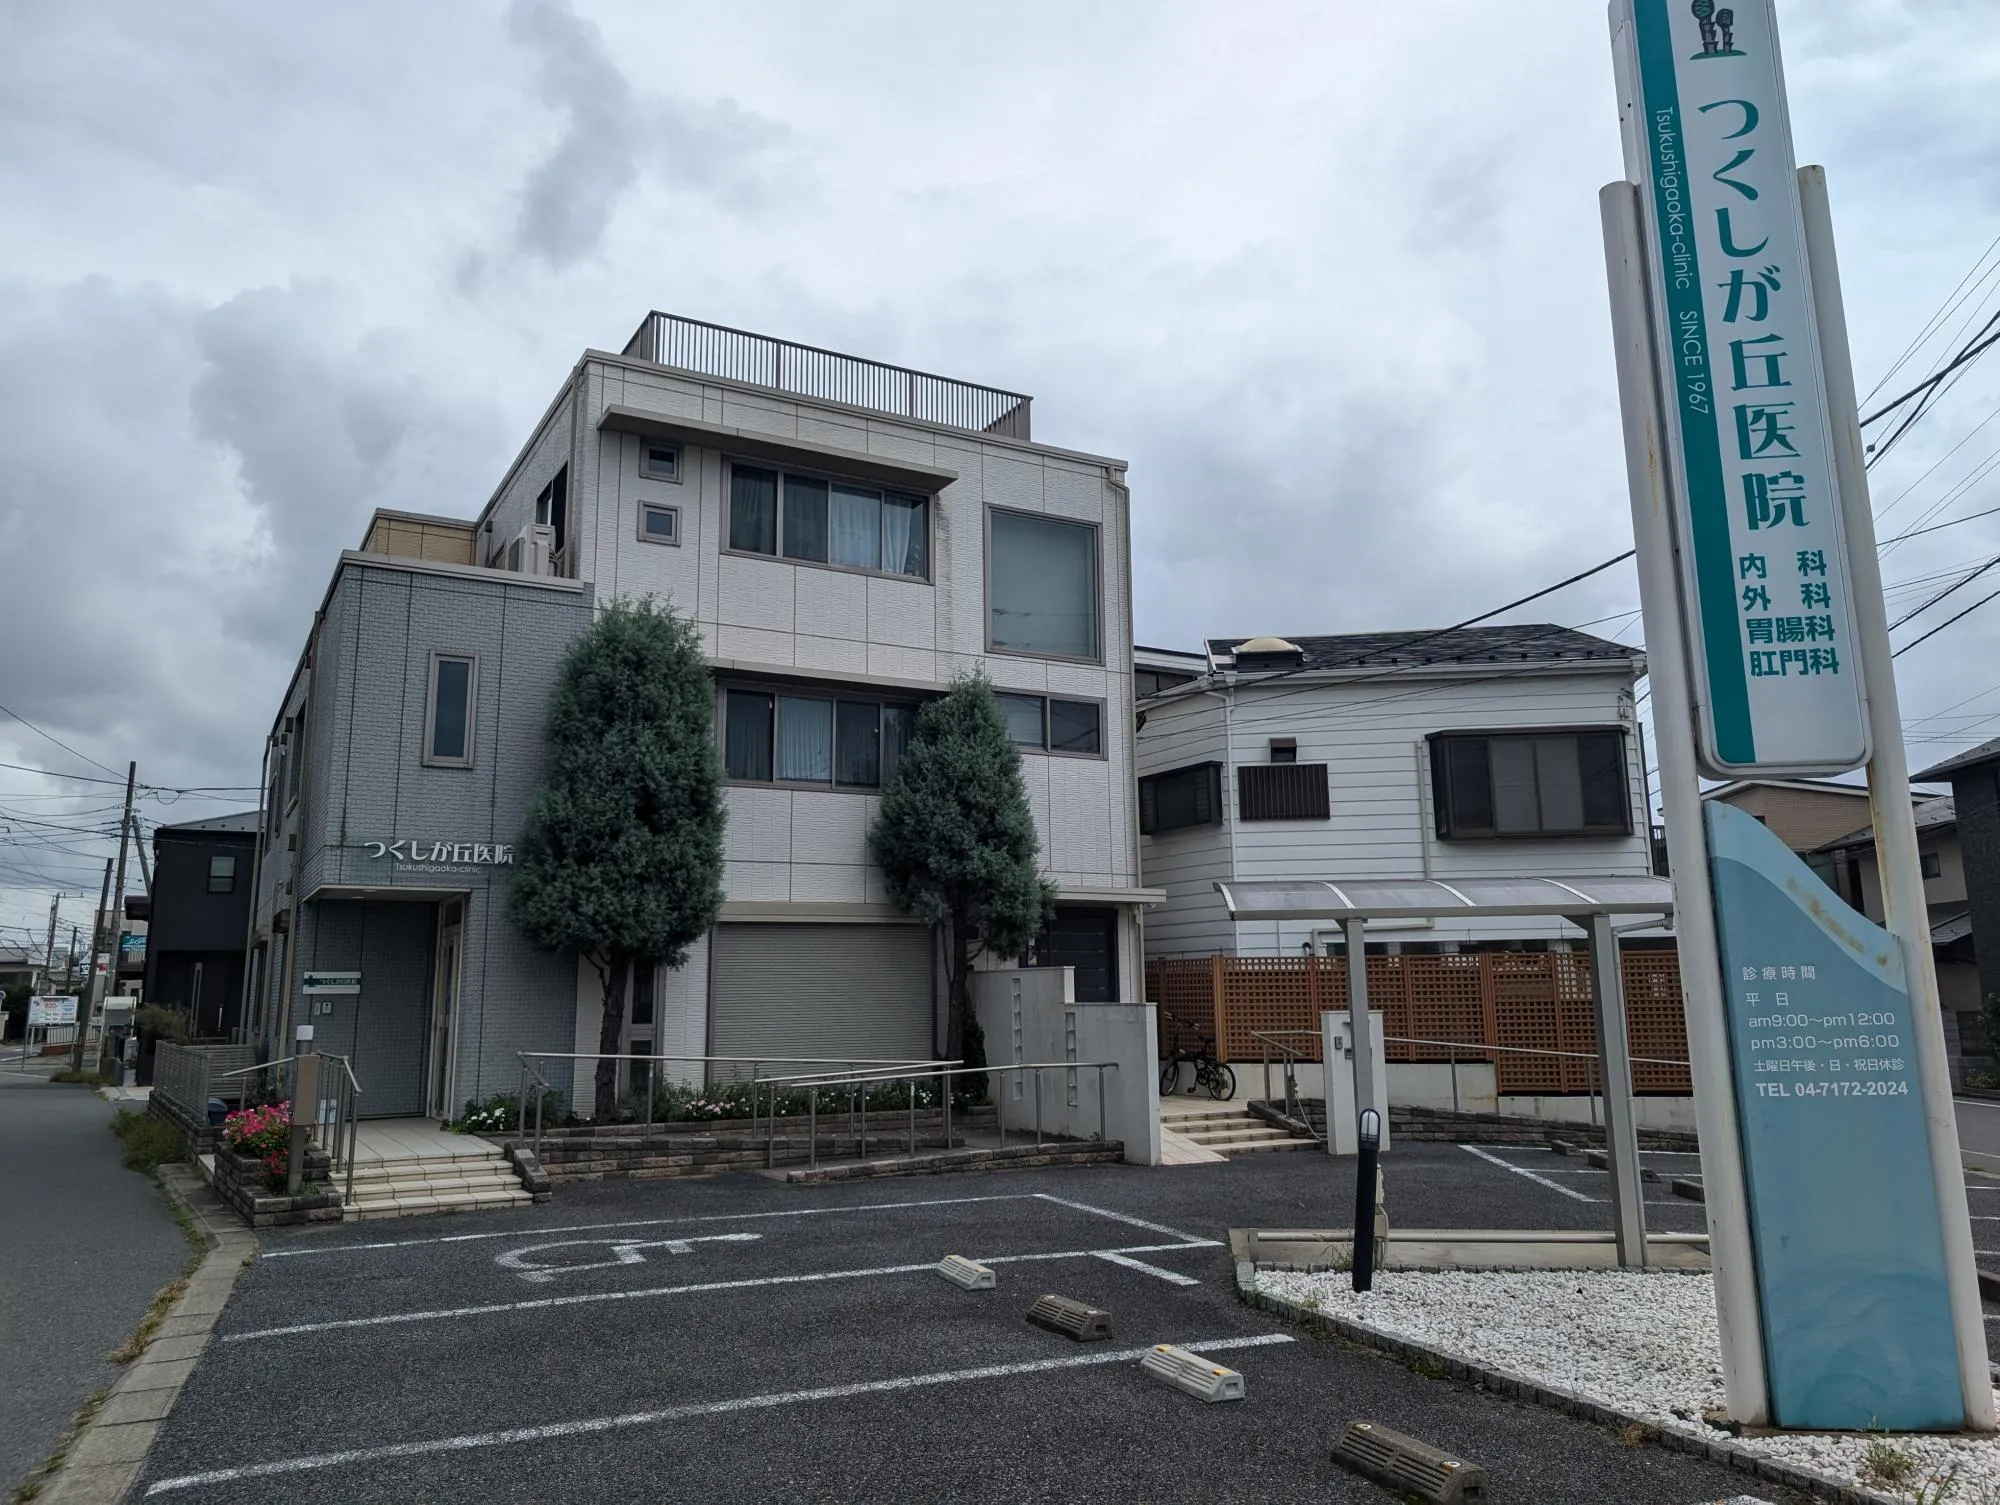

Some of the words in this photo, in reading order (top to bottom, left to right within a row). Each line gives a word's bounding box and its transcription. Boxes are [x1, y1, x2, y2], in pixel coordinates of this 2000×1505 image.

[1656, 106, 1690, 289] Tsukushigaoka-clinic
[1698, 98, 1810, 531] つくしが丘医院
[1679, 311, 1702, 366] SINCE
[1687, 374, 1709, 414] 1967
[1746, 614, 1836, 645] 胃腸科
[1749, 647, 1840, 678] 肛門科
[363, 840, 517, 865] つくしが丘医院
[395, 862, 481, 874] Tsukushigaoka-clinic
[1742, 965, 1816, 981] 診療時間
[1755, 1082, 1790, 1097] TEL
[1795, 1080, 1909, 1097] 04-7172-2024
